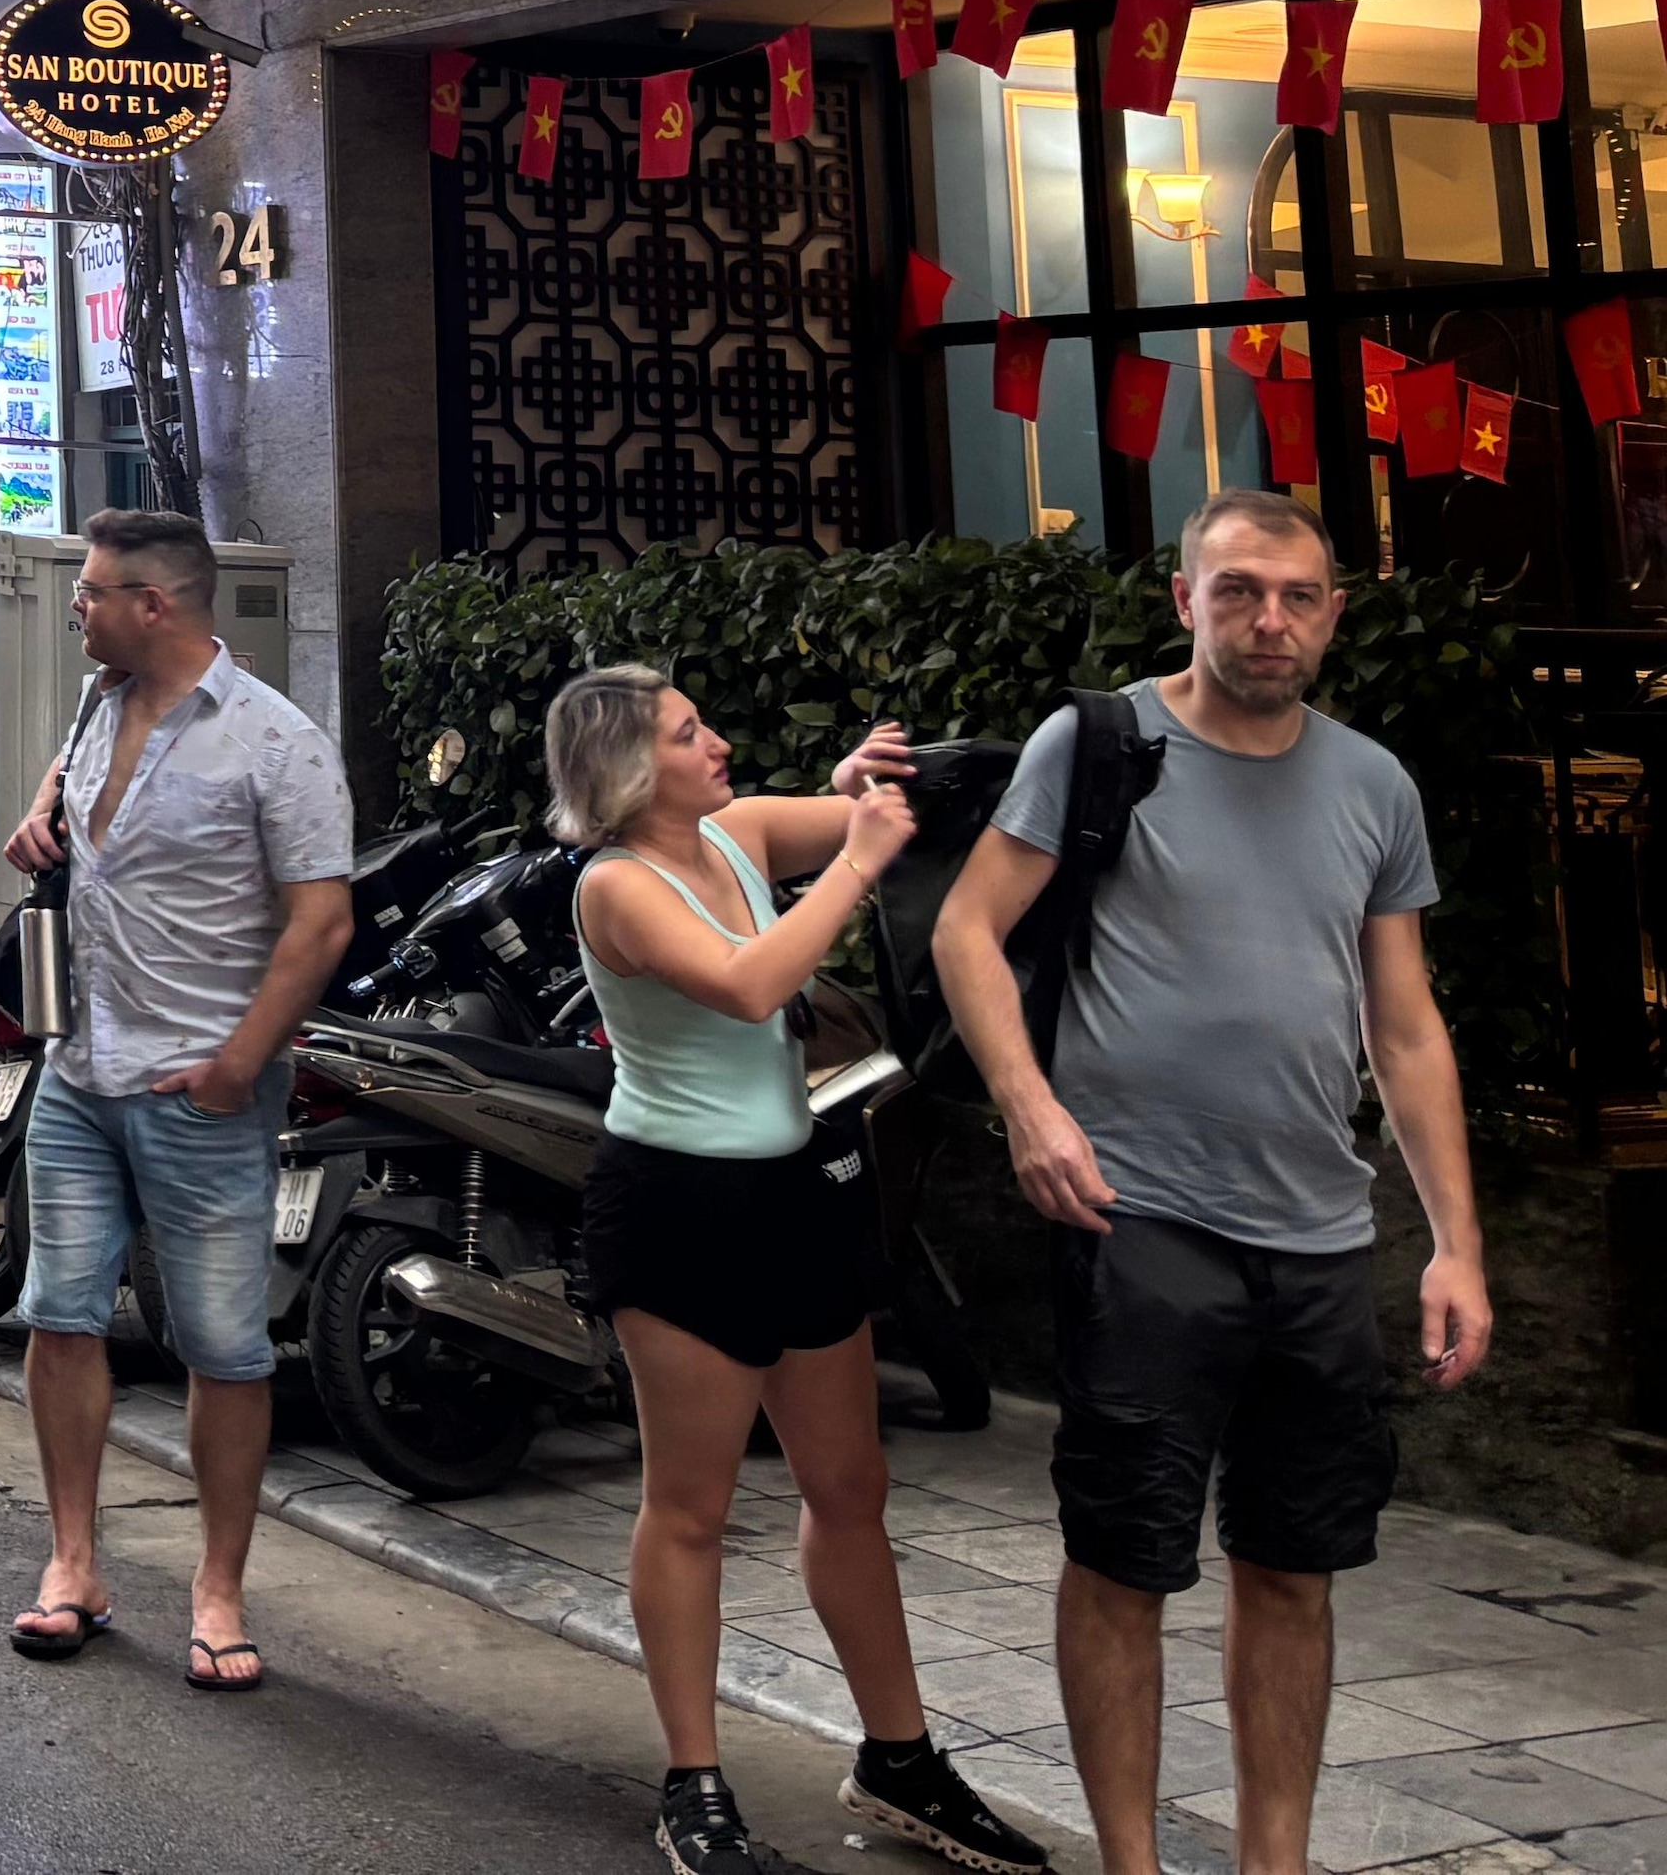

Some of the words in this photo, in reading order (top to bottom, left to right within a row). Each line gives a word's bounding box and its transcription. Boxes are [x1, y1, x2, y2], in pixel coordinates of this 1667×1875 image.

[7, 53, 59, 81] SAN
[68, 56, 209, 93] BOUTIQUE
[23, 99, 47, 123] 24
[58, 92, 161, 115] HOTEL
[211, 204, 277, 286] 24
[100, 361, 115, 376] 28
